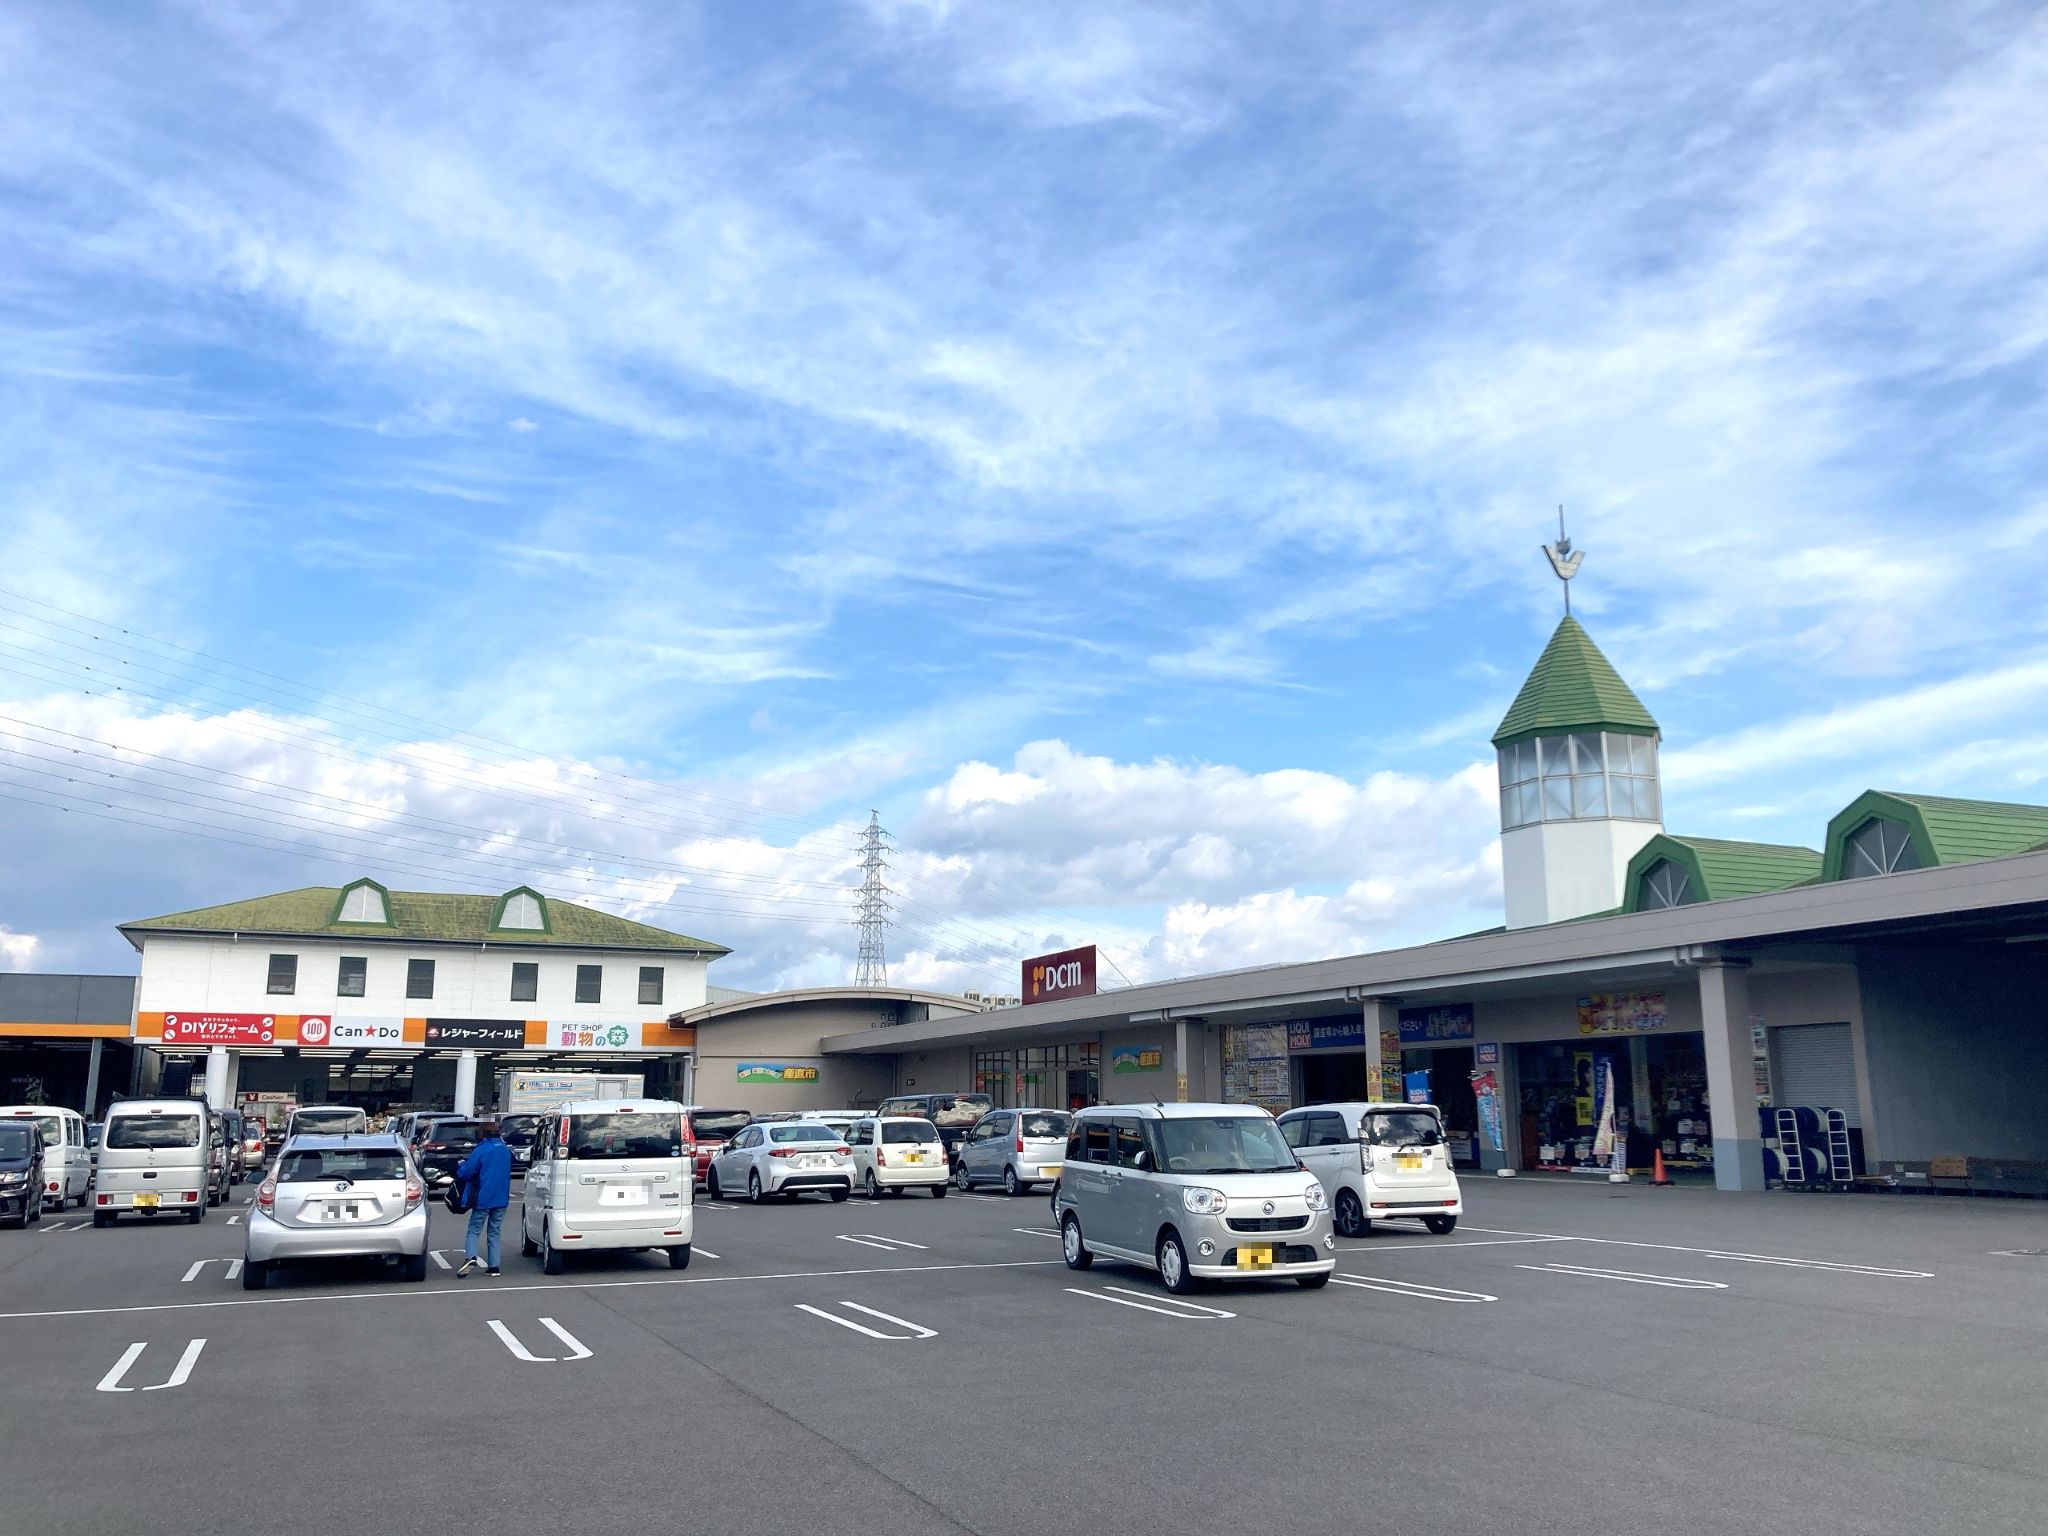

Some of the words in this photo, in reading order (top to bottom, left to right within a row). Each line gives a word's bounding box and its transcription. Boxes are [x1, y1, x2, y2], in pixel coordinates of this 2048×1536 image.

[1045, 961, 1082, 992] DCM
[181, 1021, 259, 1034] DIYリフォーム
[306, 1022, 323, 1035] 100
[334, 1025, 363, 1037] Can
[379, 1027, 399, 1038] Do
[441, 1027, 524, 1039] レジャーフィールド
[561, 1023, 578, 1031] PET
[581, 1024, 603, 1032] SHOP
[1289, 1021, 1310, 1034] LIQUI
[561, 1029, 628, 1047] 動物の森
[1290, 1033, 1311, 1047] MOLY
[783, 1067, 817, 1080] 産直市
